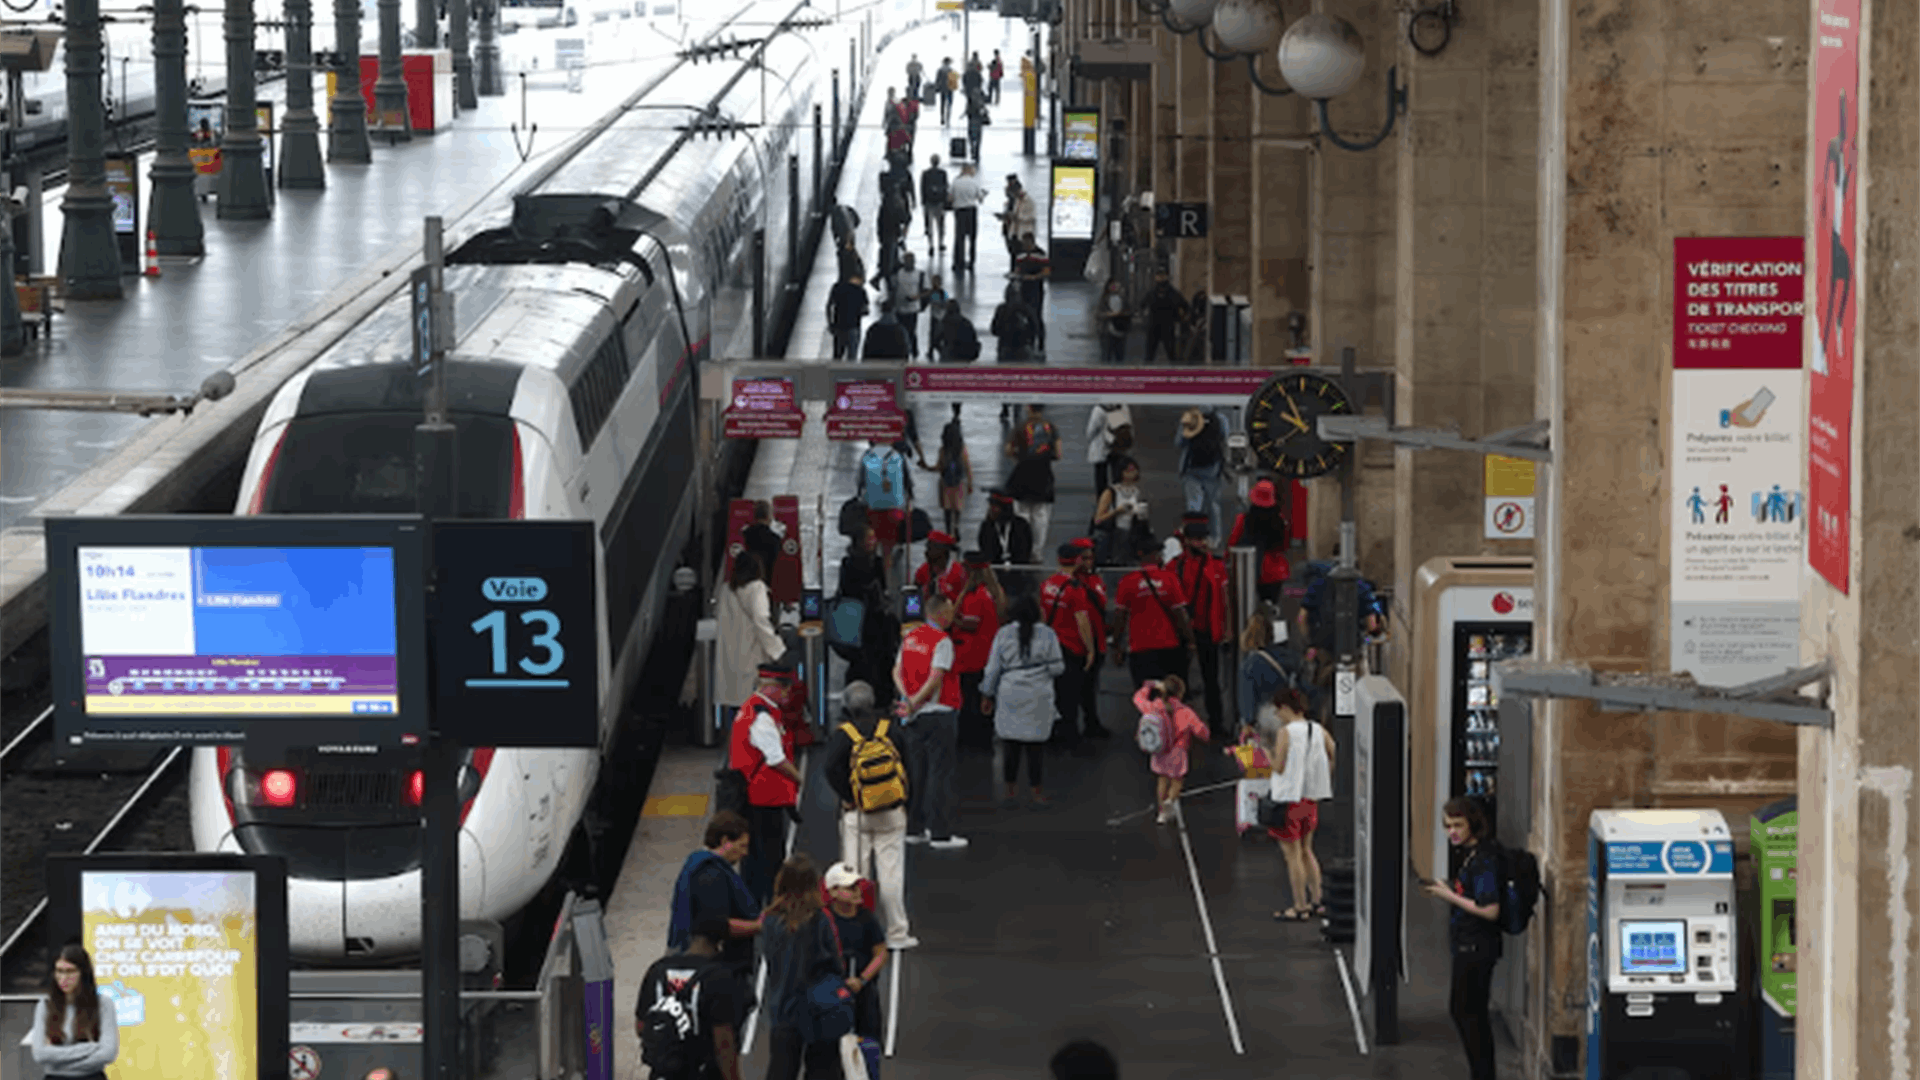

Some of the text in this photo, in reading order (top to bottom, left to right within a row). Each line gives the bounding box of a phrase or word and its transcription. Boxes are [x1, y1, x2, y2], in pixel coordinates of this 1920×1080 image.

[1181, 210, 1199, 236] R
[1688, 259, 1802, 277] VÉRIFICATION
[1688, 283, 1778, 297] DES TITRES
[1688, 303, 1710, 316] DE
[1688, 323, 1788, 334] TICKET CHECKING
[86, 565, 136, 578] 10h14
[86, 588, 186, 600] Lille Flandres
[489, 580, 540, 598] Voie
[470, 609, 565, 676] 13
[140, 924, 164, 936] DU
[95, 937, 183, 949] ON SE VOIT
[95, 951, 241, 963] CHEZ CARREFOUR
[95, 964, 113, 976] ET
[117, 964, 142, 976] ON
[189, 964, 233, 976] QUOI
